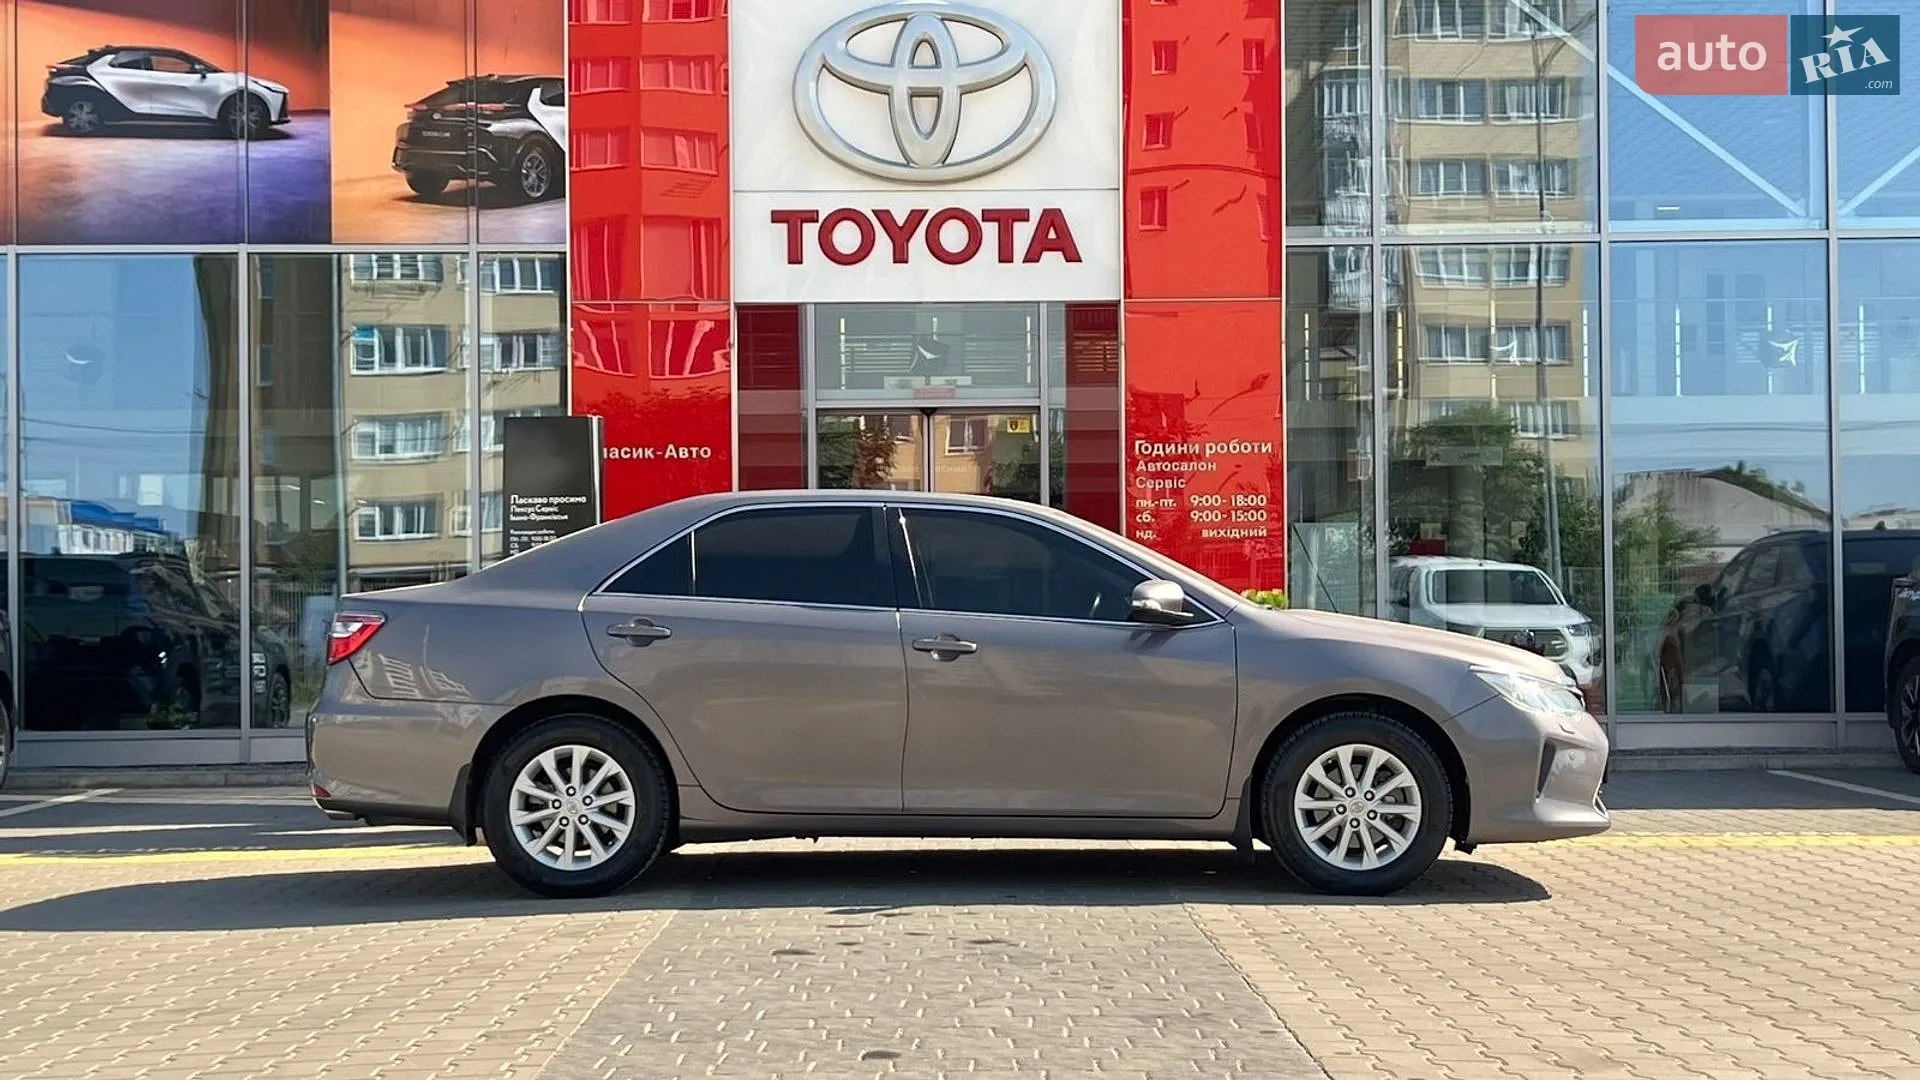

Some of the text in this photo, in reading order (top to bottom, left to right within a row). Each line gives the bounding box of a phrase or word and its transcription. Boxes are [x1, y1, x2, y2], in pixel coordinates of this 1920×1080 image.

[770, 206, 1083, 266] TOYOTA
[1135, 439, 1272, 457] Години роботи
[1136, 461, 1217, 472] Автосалон
[1136, 476, 1186, 489] Сервіс
[1201, 526, 1267, 538] вихідний
